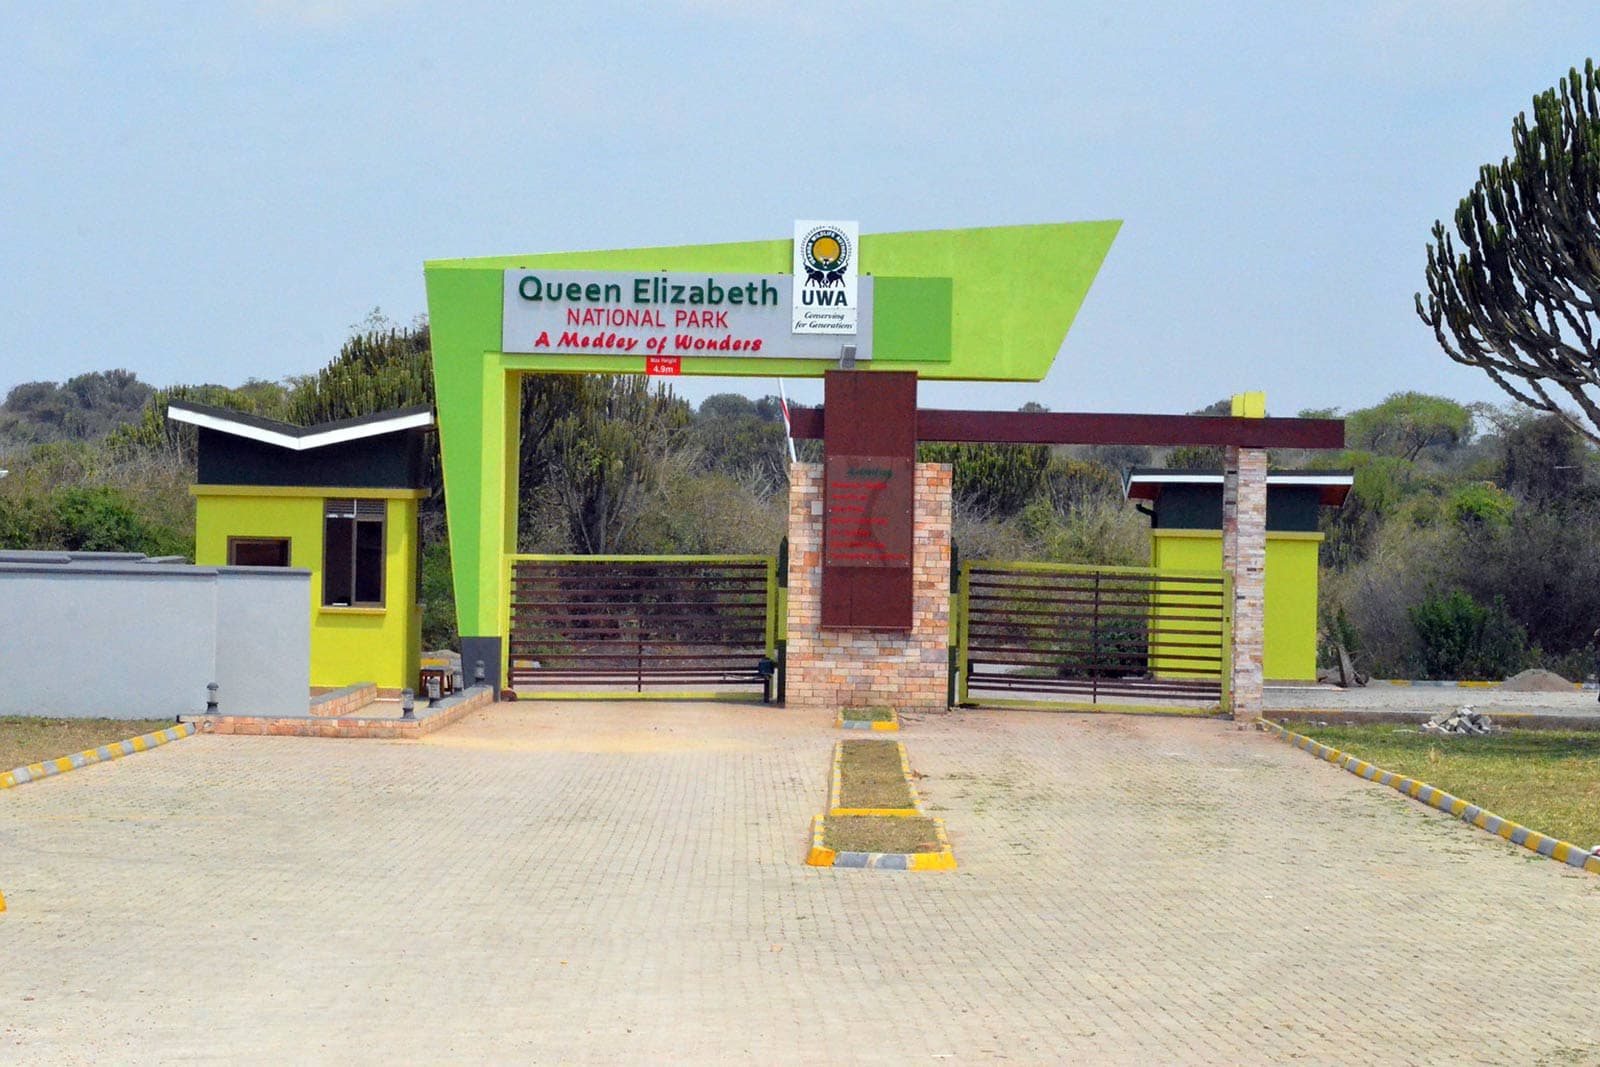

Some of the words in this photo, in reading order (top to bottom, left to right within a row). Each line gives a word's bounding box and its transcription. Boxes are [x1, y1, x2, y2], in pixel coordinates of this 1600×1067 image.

[518, 275, 621, 303] Queen
[633, 276, 778, 306] Elizabeth
[802, 290, 848, 307] UWA
[567, 308, 666, 327] NATIONAL
[675, 309, 729, 329] PARK
[804, 311, 845, 321] Conserving
[795, 320, 807, 330] for
[809, 320, 853, 330] Generations
[534, 331, 550, 348] A
[557, 331, 639, 352] Medley
[646, 336, 668, 354] of
[674, 334, 763, 352] Wonders
[652, 365, 674, 374] 4.9m
